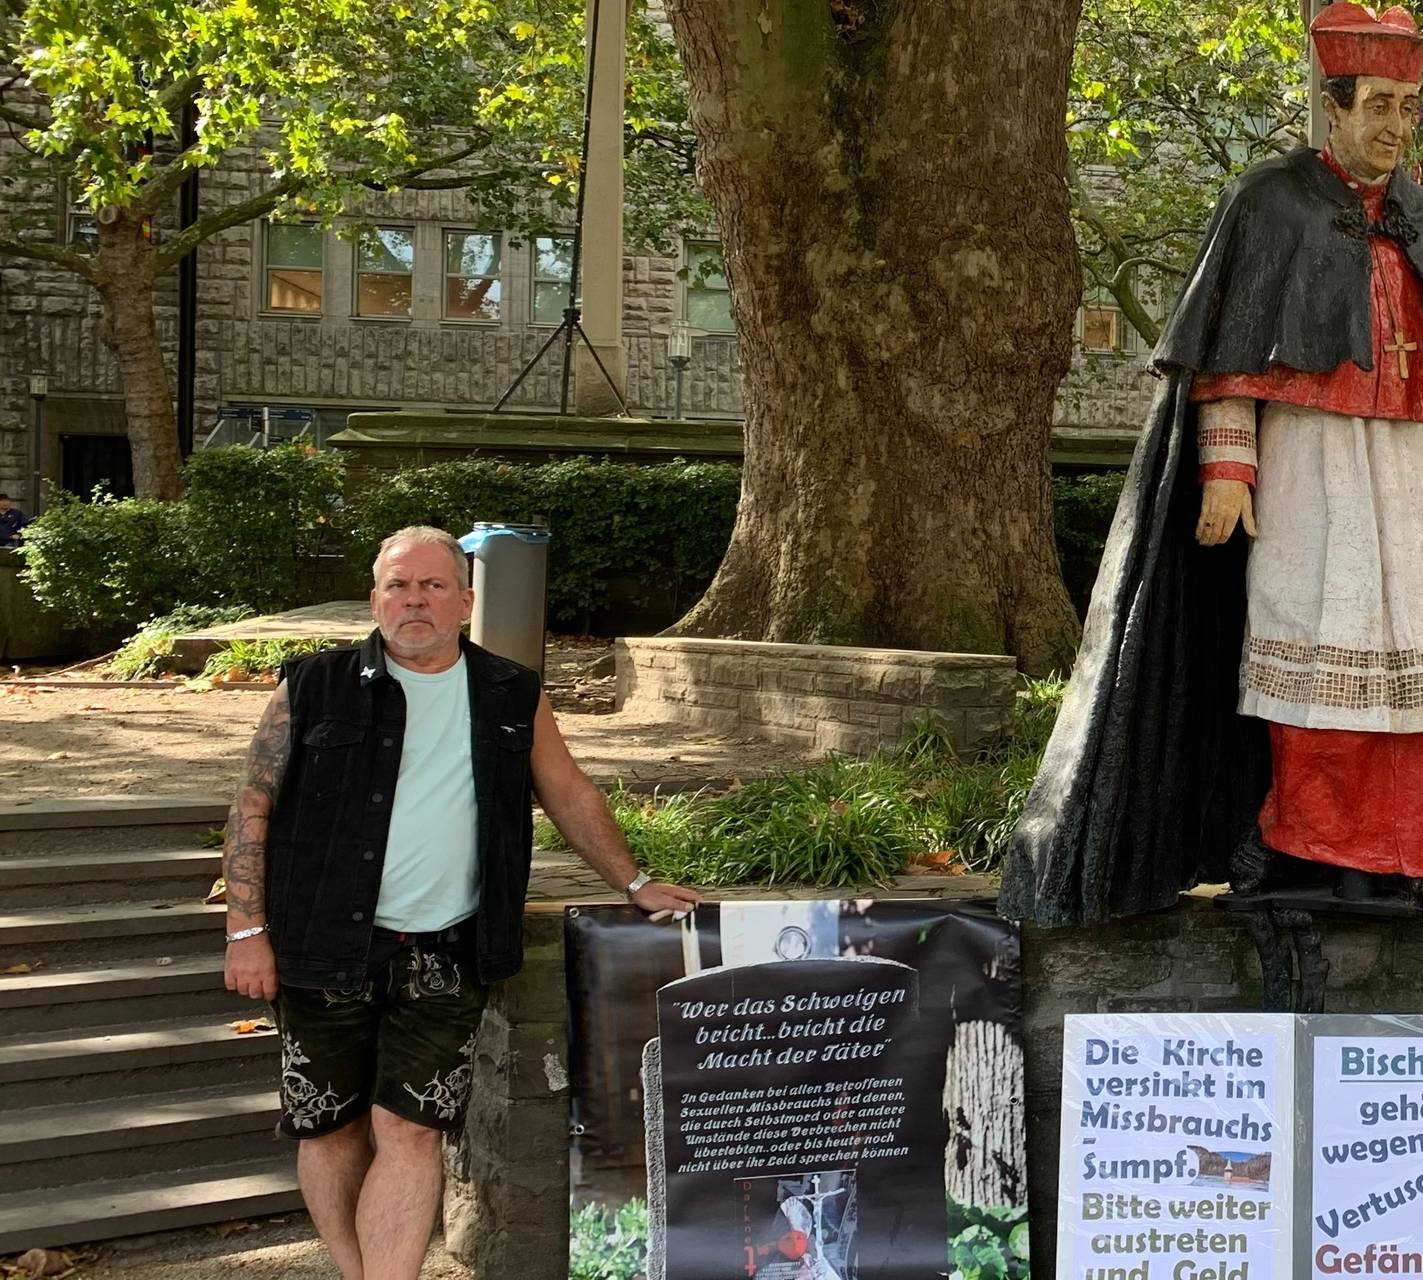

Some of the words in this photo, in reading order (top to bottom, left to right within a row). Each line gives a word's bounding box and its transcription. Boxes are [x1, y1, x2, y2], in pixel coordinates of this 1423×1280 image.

[733, 998, 775, 1016] das
[780, 988, 906, 1013] Schweigen
[849, 1014, 886, 1033] die
[697, 1049, 773, 1070] Macht
[776, 1047, 817, 1065] der
[1085, 1039, 1139, 1066] Die
[1162, 1039, 1263, 1067] Kirche
[681, 1093, 697, 1104] In
[699, 1088, 765, 1103] Gedanken
[767, 1085, 788, 1098] bei
[789, 1084, 822, 1096] allen
[825, 1077, 903, 1093] Betroffenen
[1086, 1071, 1216, 1098] versinkt
[1225, 1074, 1265, 1099] im
[680, 1105, 745, 1118] Sexuellen
[746, 1097, 832, 1113] Missbrauchs
[834, 1095, 858, 1106] und
[863, 1091, 905, 1104] denen,
[680, 1119, 701, 1132] die
[703, 1116, 742, 1130] durch
[744, 1112, 821, 1127] Selbstmord
[823, 1108, 856, 1121] oder
[858, 1104, 906, 1117] andere
[685, 1130, 751, 1145] Umstände
[753, 1128, 789, 1141] diese
[791, 1121, 867, 1137] Verbrechen
[869, 1118, 902, 1130] nicht
[1080, 1101, 1272, 1142] Missbrauchs
[804, 1137, 823, 1149] bis
[825, 1134, 861, 1147] heute
[864, 1132, 895, 1145] noch
[678, 1159, 711, 1173] nicht
[713, 1157, 744, 1170] über
[746, 1156, 765, 1168] ihr
[767, 1154, 796, 1167] Leid
[799, 1149, 859, 1164] sprechen
[861, 1146, 909, 1159] können
[1082, 1149, 1197, 1184] Sumpf.
[1081, 1193, 1162, 1221] Bitte
[1168, 1193, 1272, 1220] weiter
[1091, 1228, 1247, 1254] austreten
[1085, 1261, 1149, 1280] und
[1173, 1260, 1249, 1280] Geld
